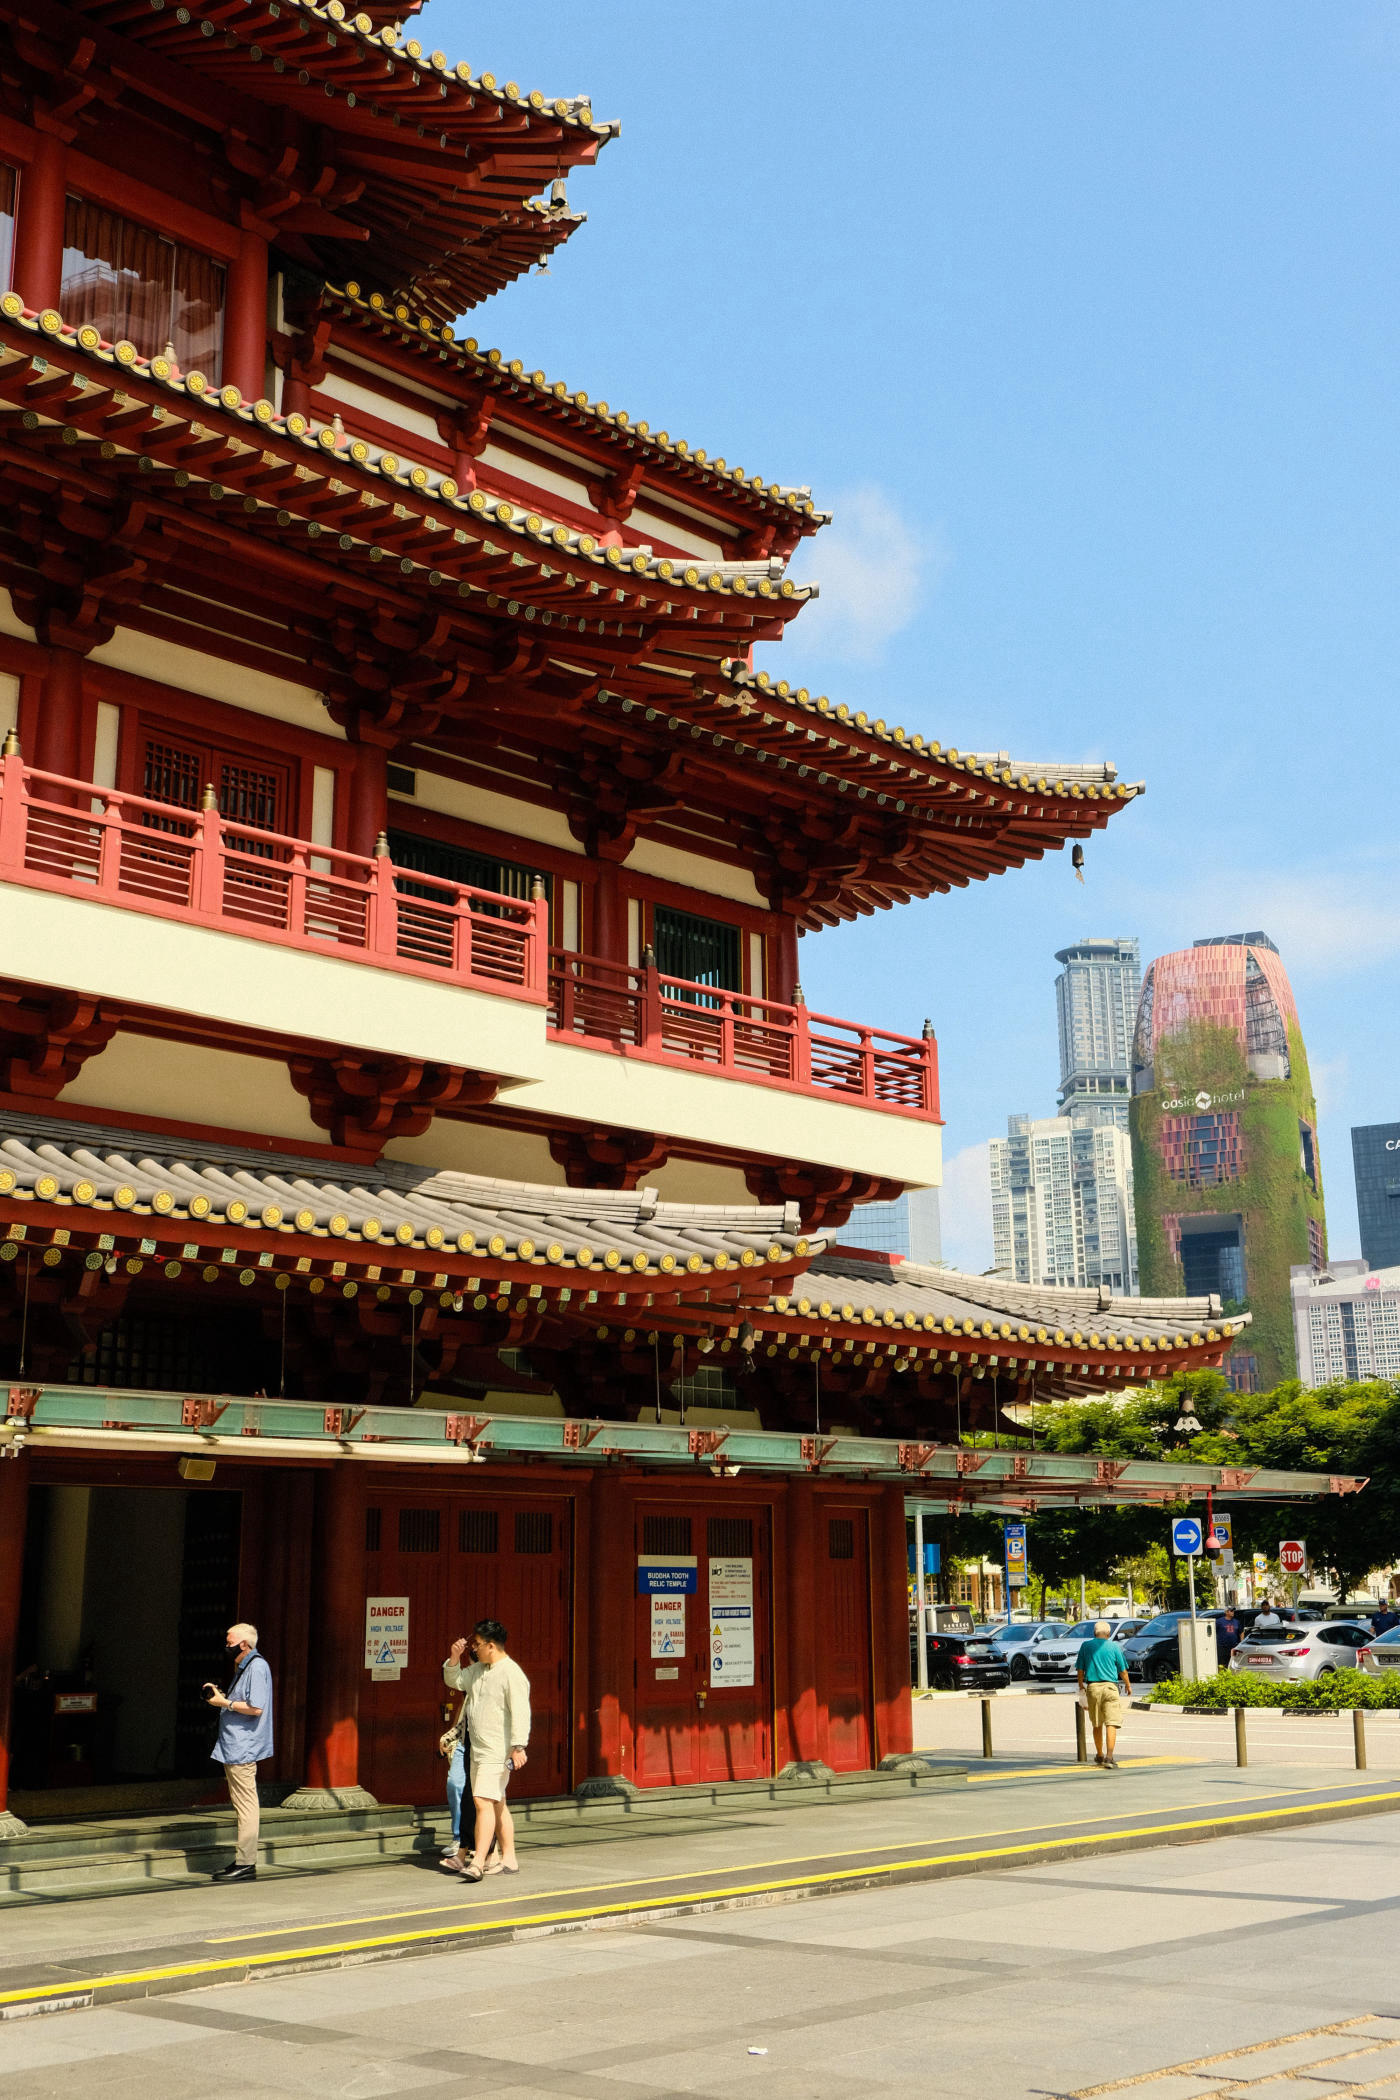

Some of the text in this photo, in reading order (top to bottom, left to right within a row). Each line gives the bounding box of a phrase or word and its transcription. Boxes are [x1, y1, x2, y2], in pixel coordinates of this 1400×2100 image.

[1213, 1088, 1245, 1104] hotel
[1281, 1550, 1303, 1563] STOP
[370, 1606, 405, 1617] DANGER
[654, 1601, 682, 1611] DANGER
